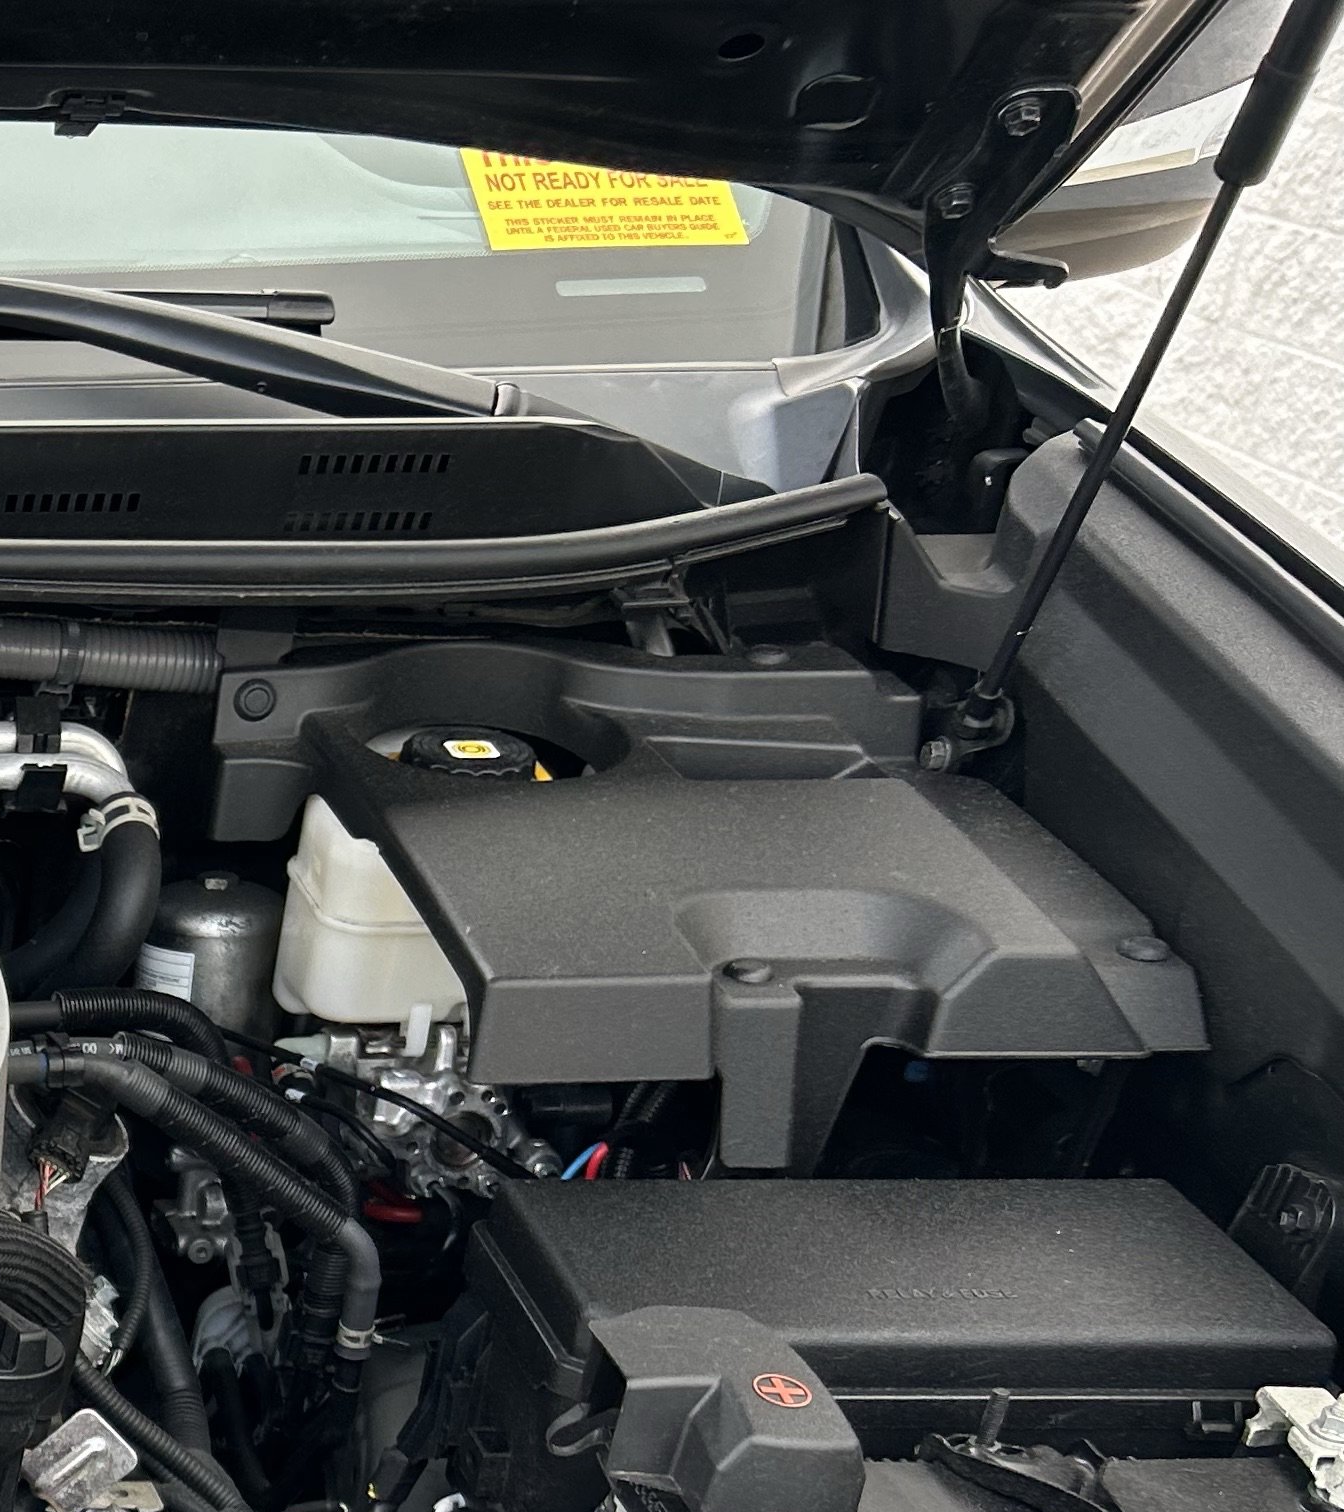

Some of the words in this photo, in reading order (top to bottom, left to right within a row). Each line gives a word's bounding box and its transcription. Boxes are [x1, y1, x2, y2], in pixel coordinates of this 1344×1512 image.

[484, 173, 527, 192] NOT
[532, 172, 601, 190] READY
[607, 171, 652, 188] FOR
[487, 200, 514, 210] SEE
[516, 199, 543, 209] THE
[546, 198, 596, 208] DEALER
[602, 197, 627, 207] FOR
[633, 196, 683, 206] RESALE
[689, 196, 721, 206] DATE
[504, 218, 530, 226] THIS
[533, 217, 578, 225] STICKER
[680, 214, 715, 222] PLACE
[506, 227, 534, 235] UNTIL
[537, 226, 544, 234] A
[547, 225, 592, 234] FEDERAL
[594, 224, 621, 232] USED
[558, 234, 600, 242] AFFIXED
[602, 233, 615, 241] TO
[618, 232, 641, 240] THIS
[866, 1288, 936, 1300] RELAY
[942, 1286, 956, 1300] &
[960, 1288, 1018, 1300] FUSE
